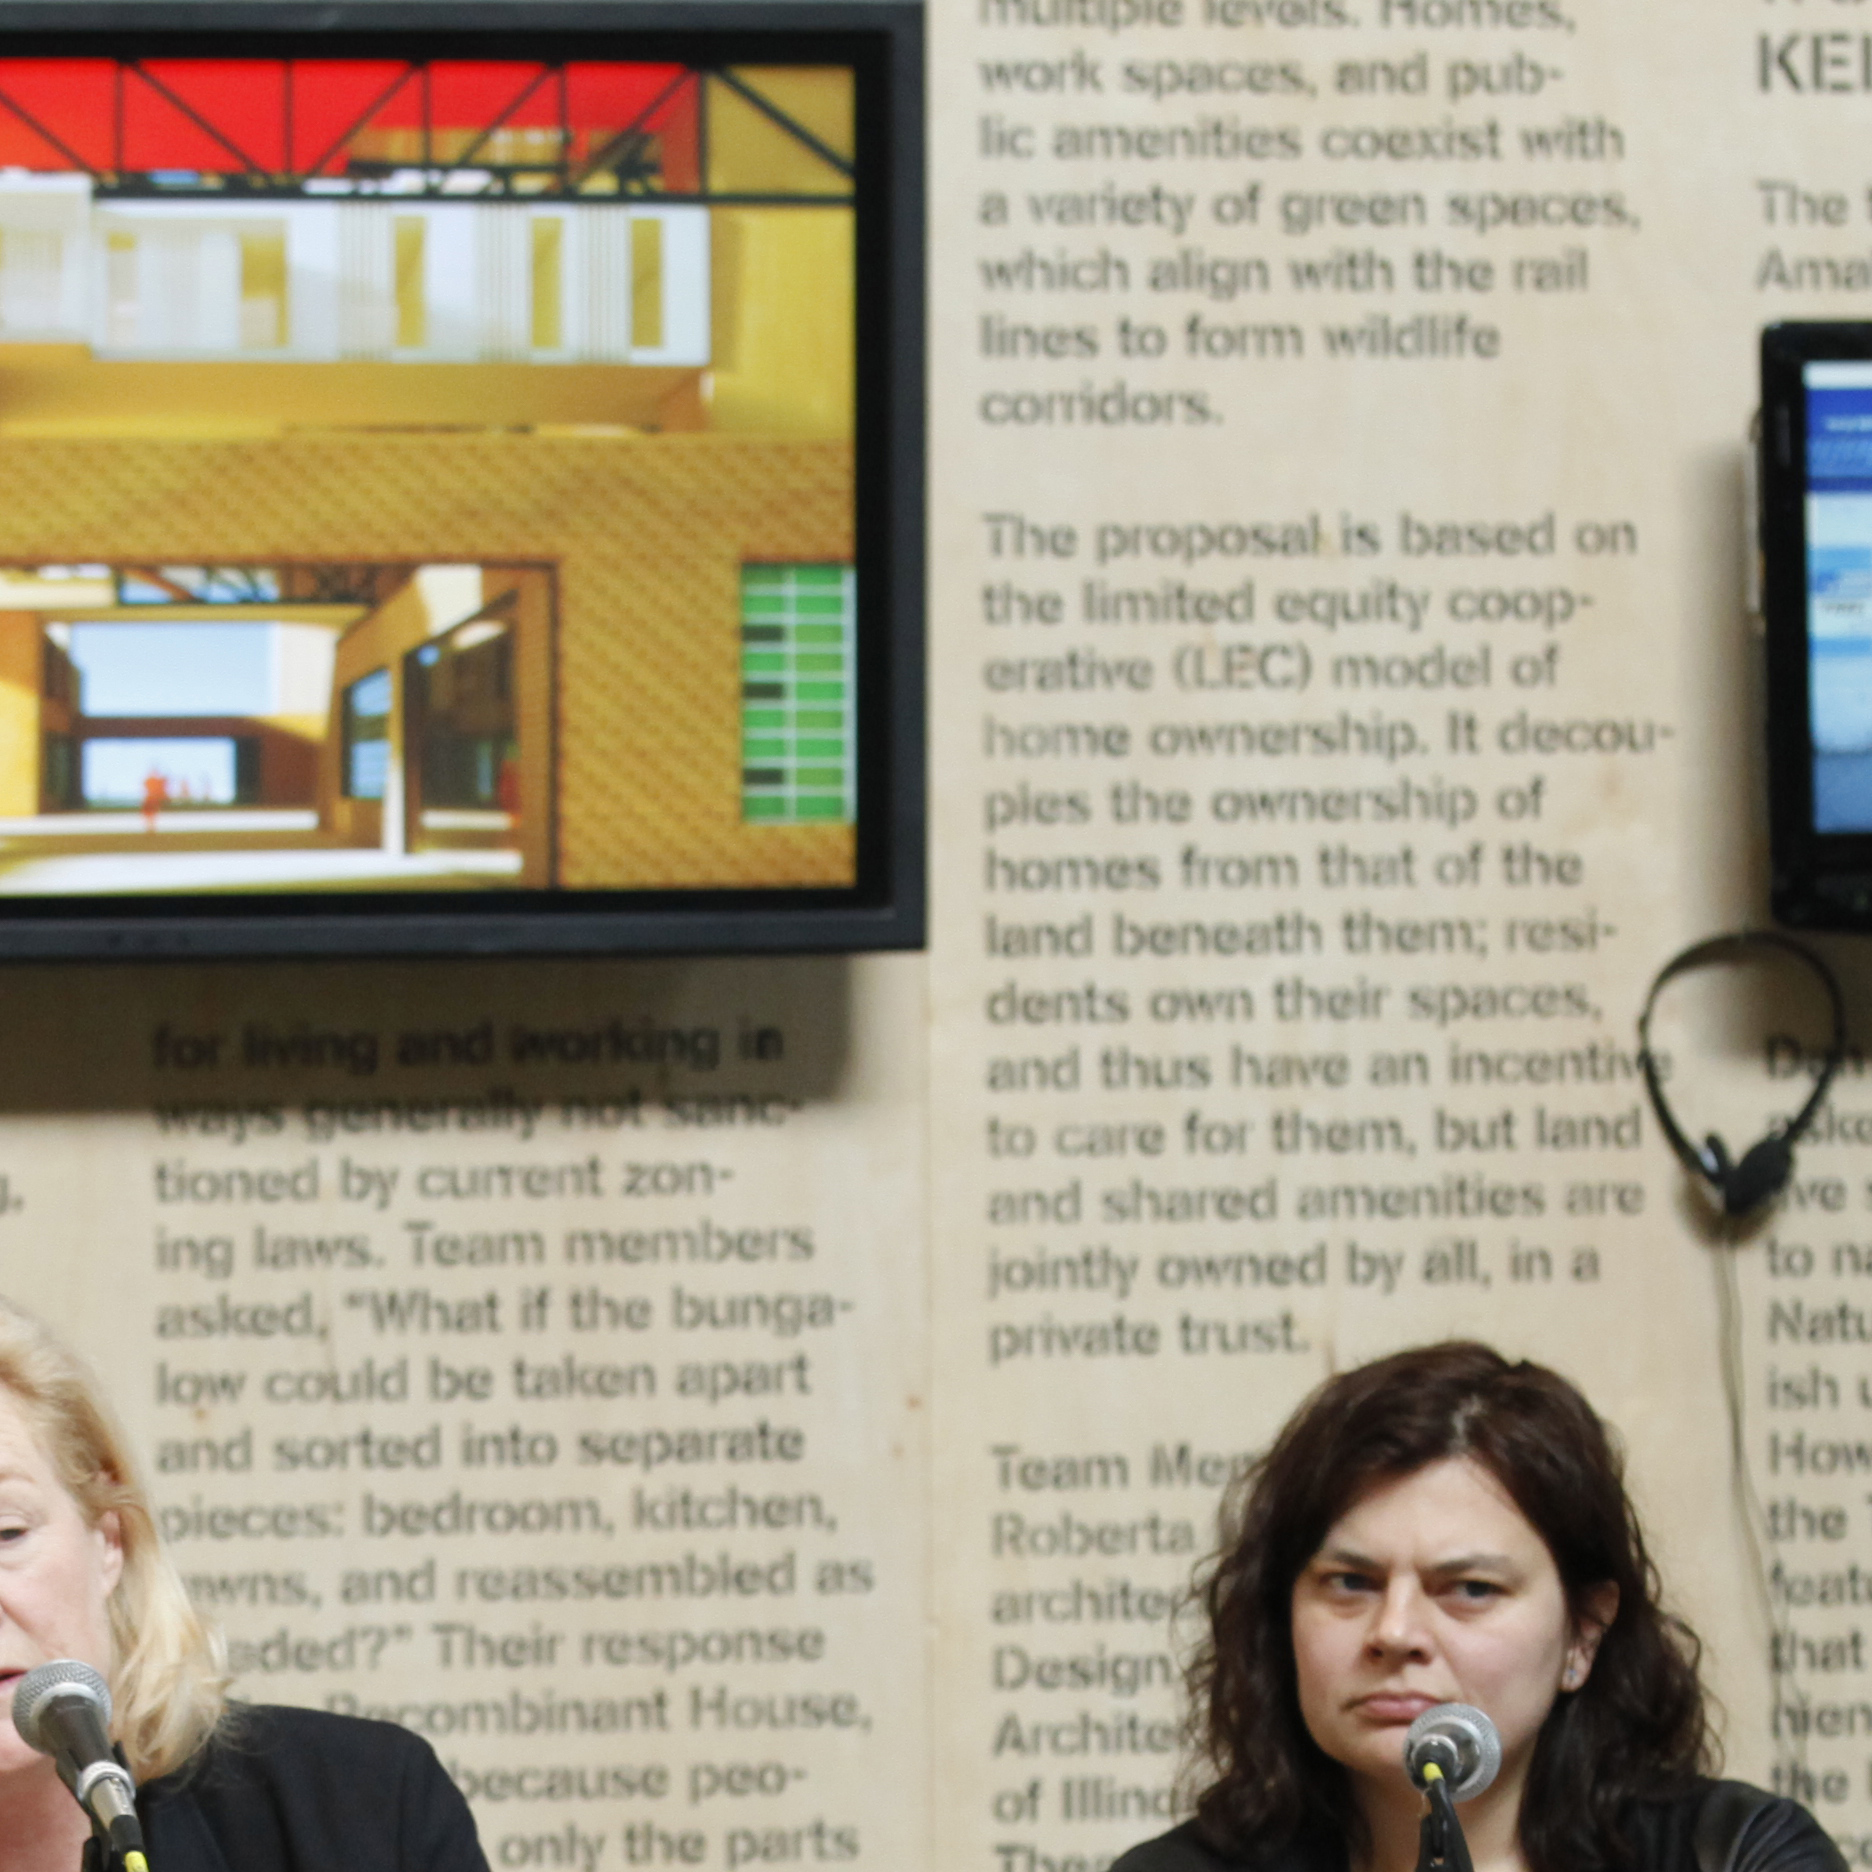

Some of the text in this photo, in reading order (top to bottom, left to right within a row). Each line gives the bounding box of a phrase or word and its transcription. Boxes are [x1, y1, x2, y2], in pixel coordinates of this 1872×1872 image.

[978, 50, 1561, 104] work spaces, and pub-
[1757, 180, 1849, 228] The
[979, 248, 1590, 302] which align with the rail
[978, 381, 1222, 426] corridors.
[983, 512, 1639, 565] The proposal is based on
[980, 579, 1595, 632] the limited equity coop-
[984, 906, 1618, 963] land beneath them; resi-
[152, 1154, 732, 1211] tioned by current zon-
[155, 1218, 816, 1280] ing laws. Team members
[988, 1309, 1311, 1365] private trust.
[155, 1420, 806, 1474] and sorted into separate
[990, 1444, 1130, 1491] Team
[361, 1484, 838, 1538] bedroom, kitchen,
[1765, 1497, 1848, 1543] the
[339, 1551, 875, 1605] and reassembled as
[431, 1620, 826, 1673] Their response
[621, 1820, 708, 1867] the
[724, 1819, 860, 1870] parts
